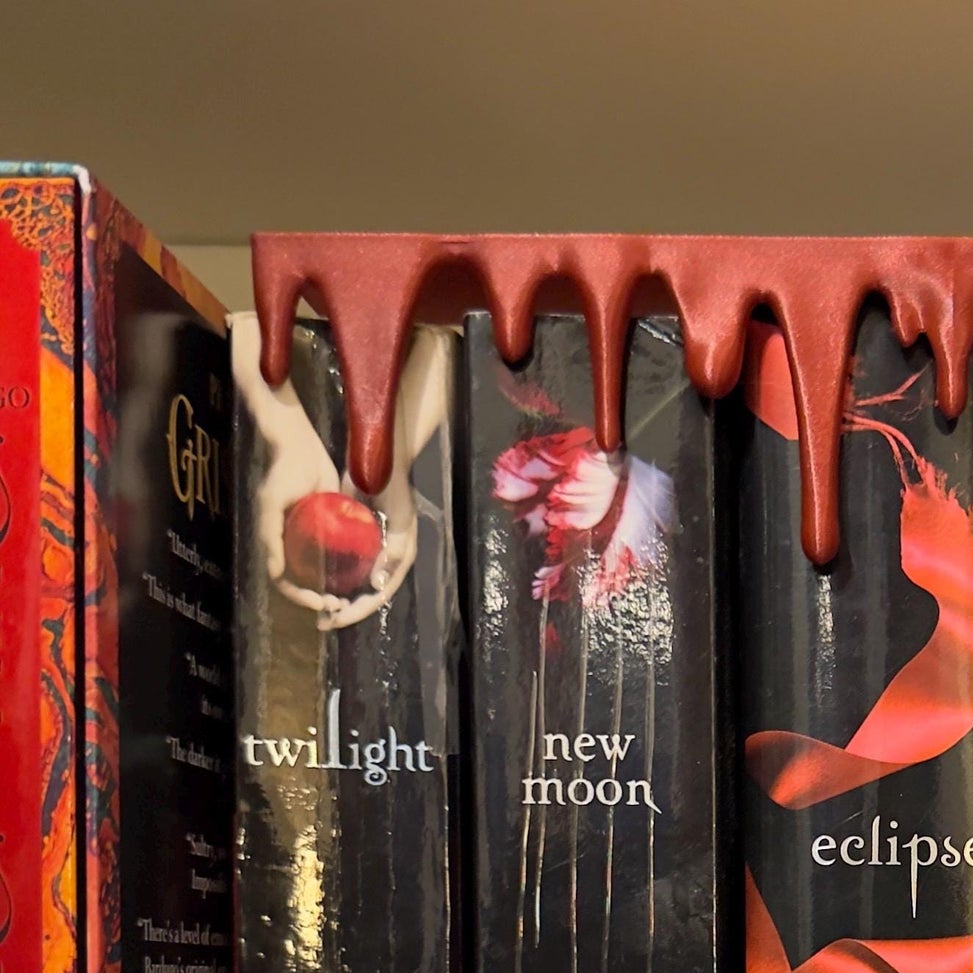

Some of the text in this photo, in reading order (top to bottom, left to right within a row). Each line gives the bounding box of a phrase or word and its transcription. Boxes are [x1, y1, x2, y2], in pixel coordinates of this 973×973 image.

[166, 393, 220, 522] GRI
[241, 688, 435, 786] twilight
[543, 733, 636, 762] new
[521, 777, 663, 814] moon
